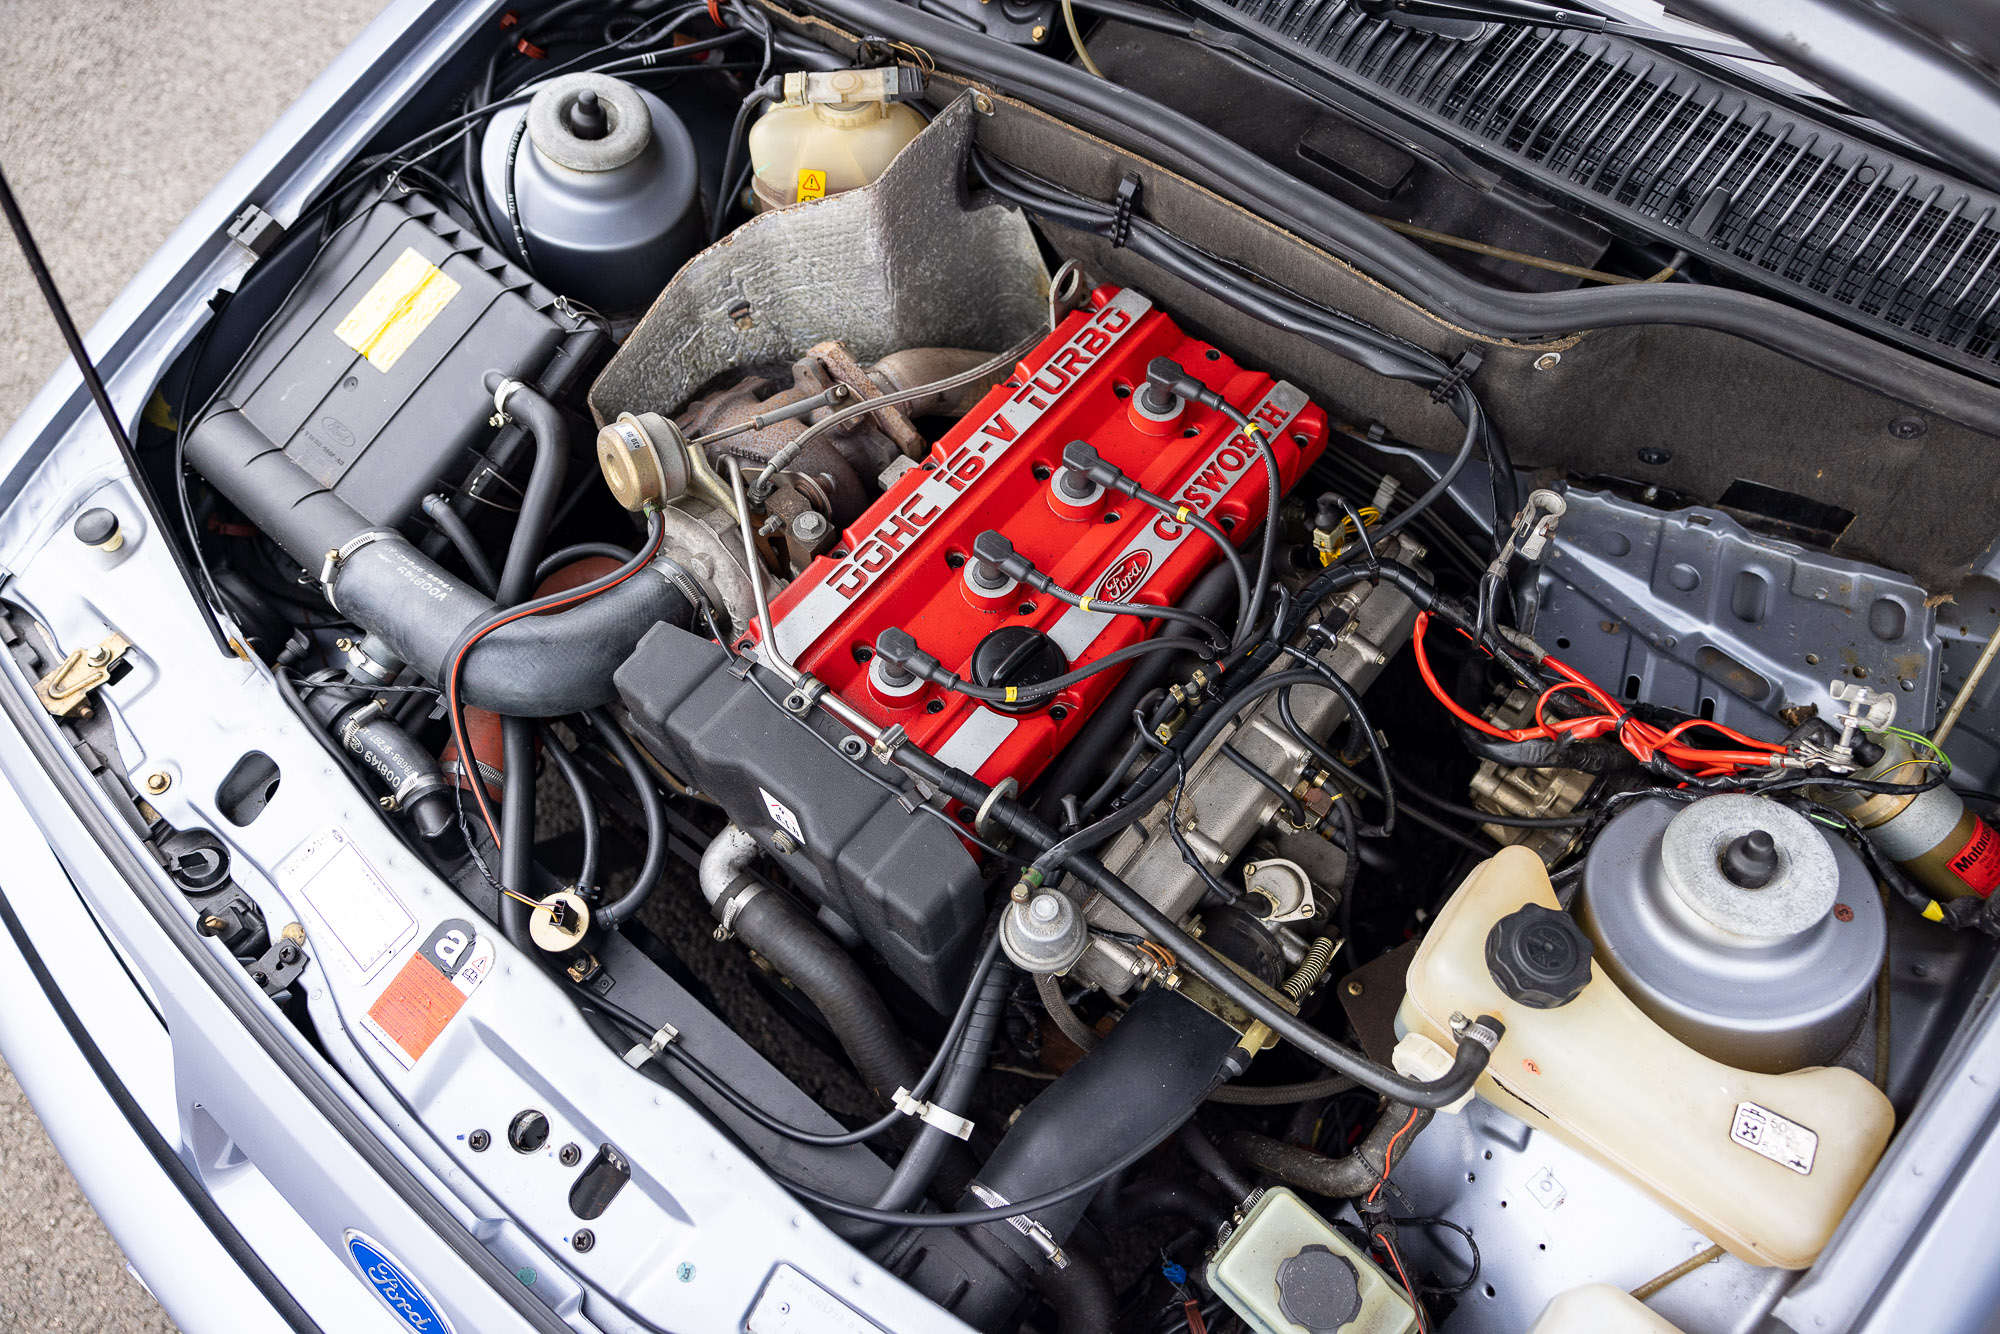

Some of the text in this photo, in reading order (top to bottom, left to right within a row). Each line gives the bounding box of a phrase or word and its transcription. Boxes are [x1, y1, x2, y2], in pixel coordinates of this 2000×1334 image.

[826, 307, 1132, 600] DOHC 16-V TURBO
[1104, 560, 1144, 600] Ford
[368, 1262, 432, 1331] Ford
